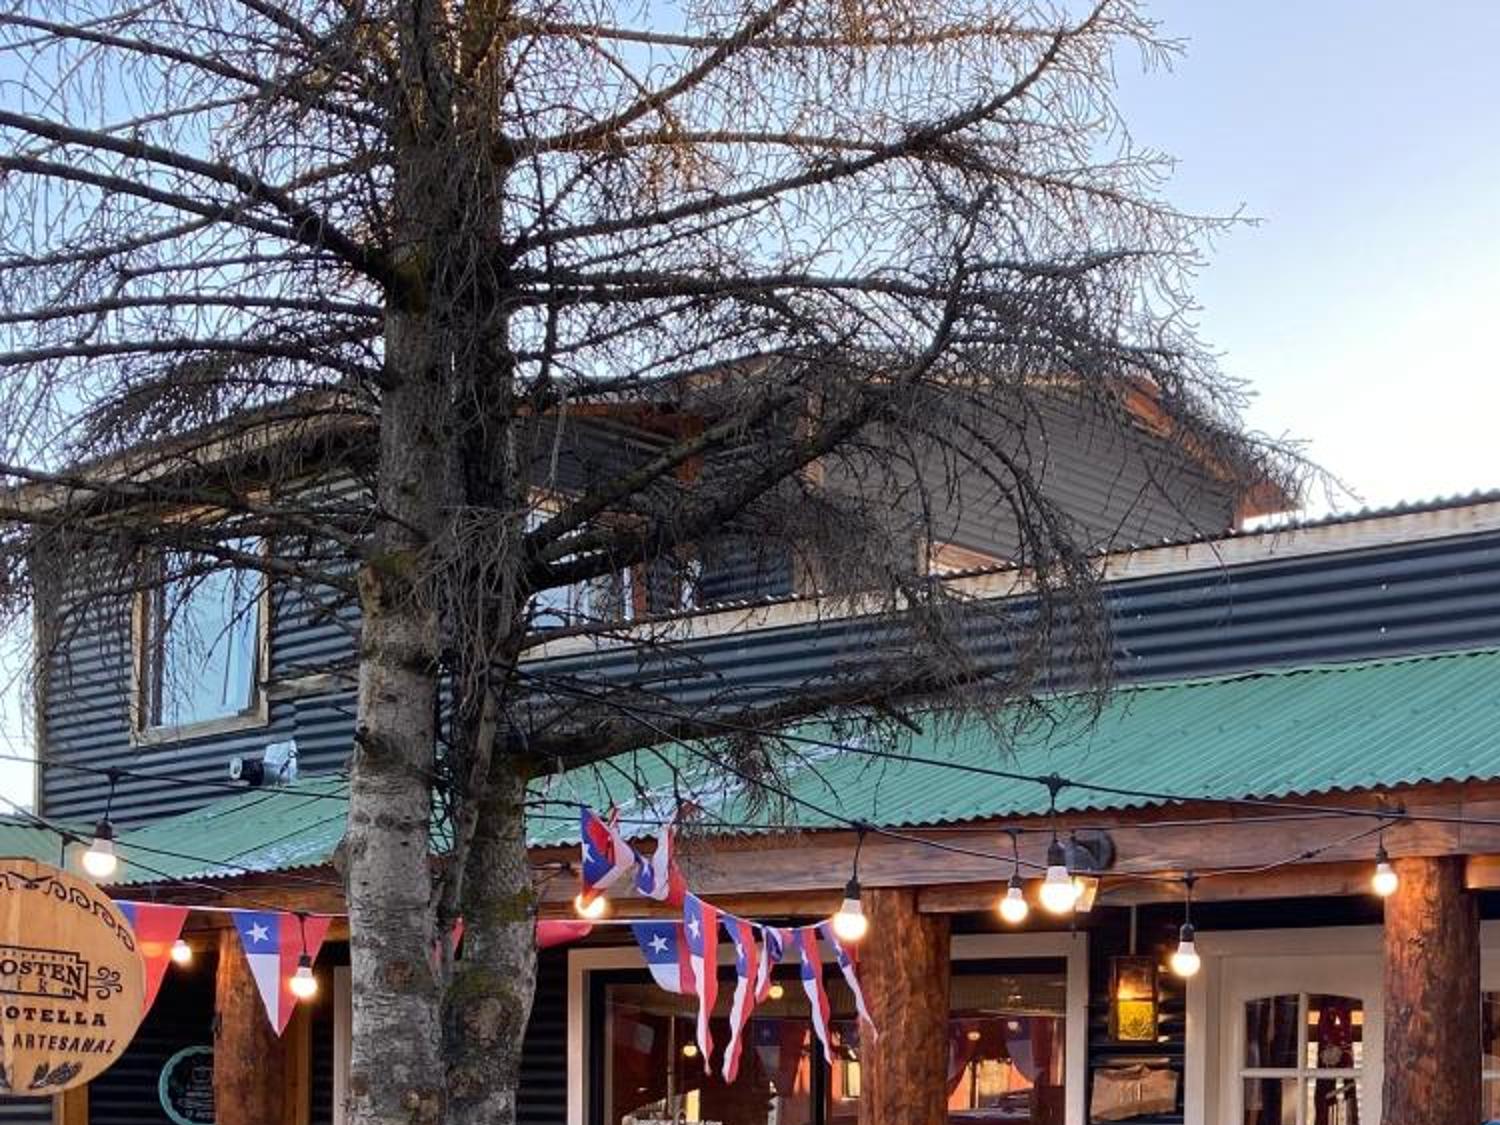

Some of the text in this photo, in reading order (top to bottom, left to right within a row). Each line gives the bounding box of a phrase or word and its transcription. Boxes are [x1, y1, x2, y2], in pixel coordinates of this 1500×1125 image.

[0, 960, 83, 990] OSTEN
[0, 1006, 106, 1026] OTELLA
[13, 1033, 115, 1054] ARTESANAL
